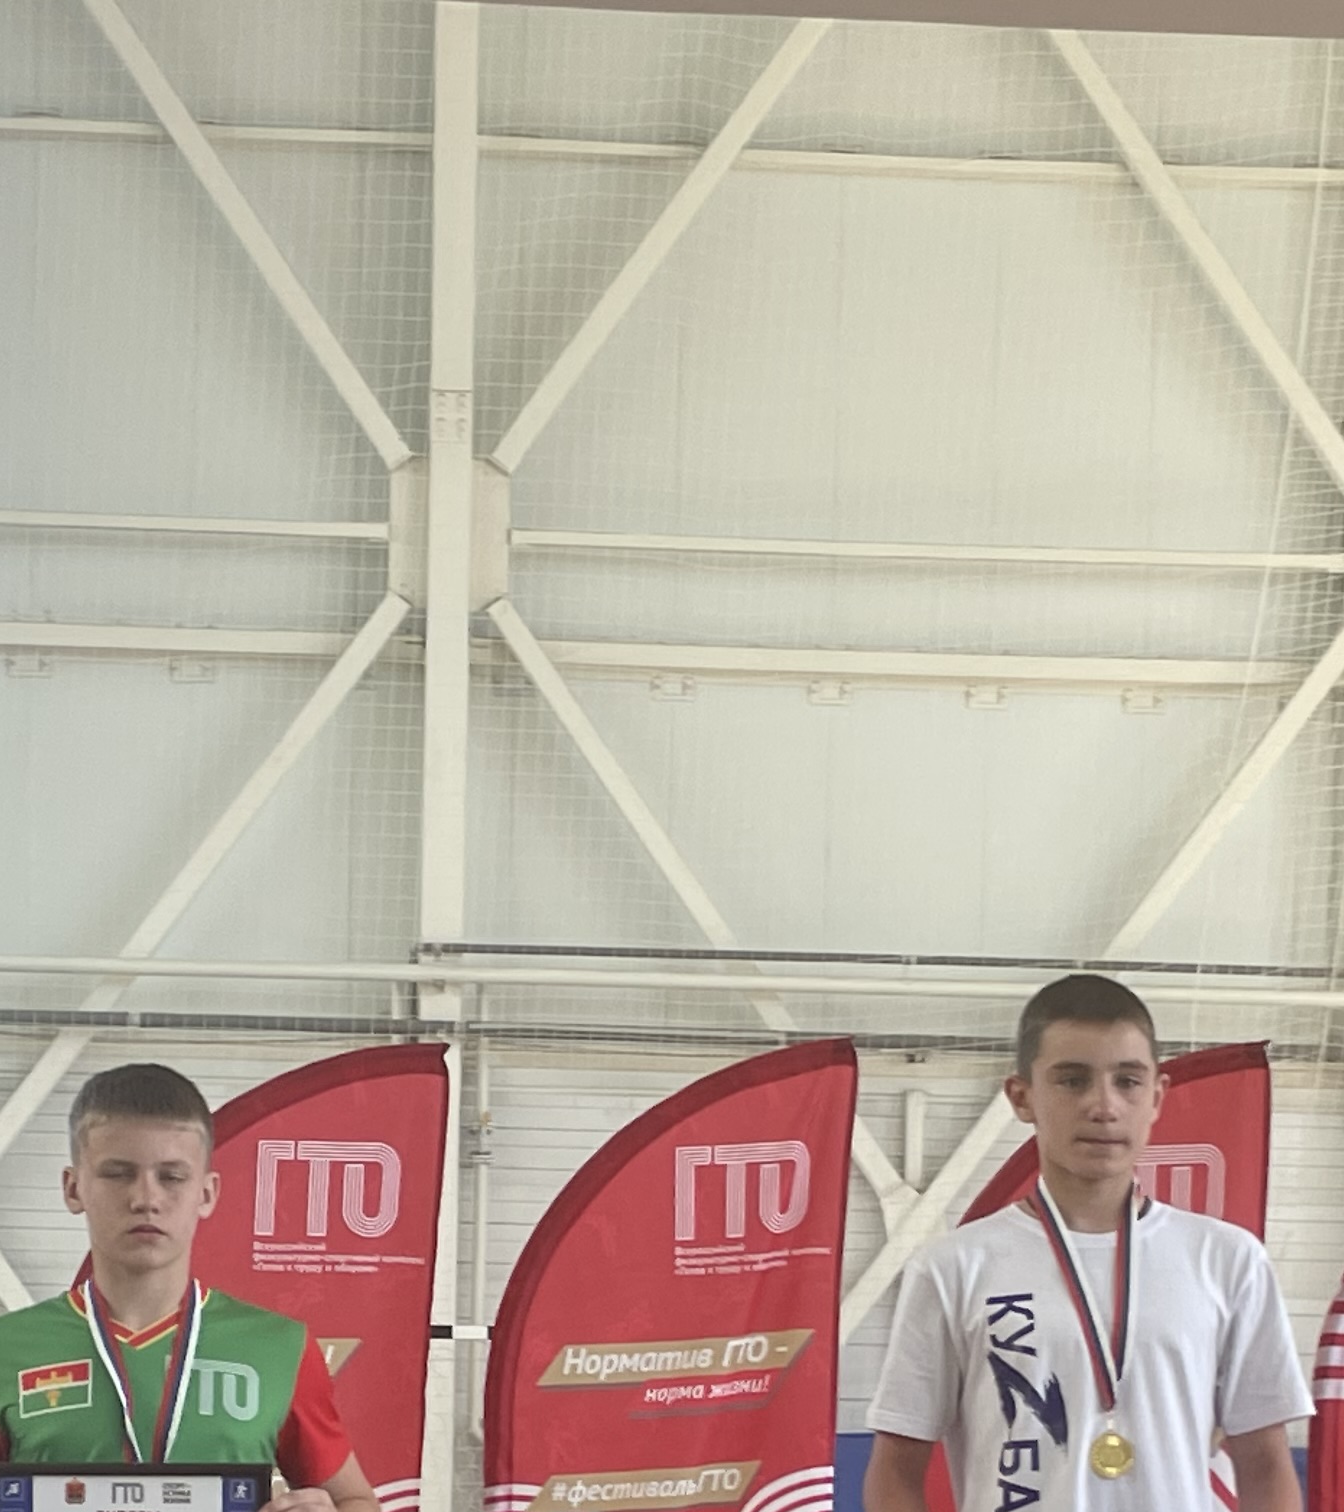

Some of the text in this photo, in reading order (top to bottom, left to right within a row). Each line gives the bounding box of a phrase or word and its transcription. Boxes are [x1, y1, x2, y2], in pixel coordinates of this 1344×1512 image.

[254, 1139, 401, 1238] ГТО
[674, 1139, 811, 1241] ГТО
[562, 1345, 714, 1381] Норматив
[722, 1335, 770, 1368] ГТО
[164, 1355, 260, 1421] ТО
[644, 1382, 704, 1405] норма
[111, 1482, 145, 1504] ГТО
[551, 1467, 743, 1507] #фестивальГТО
